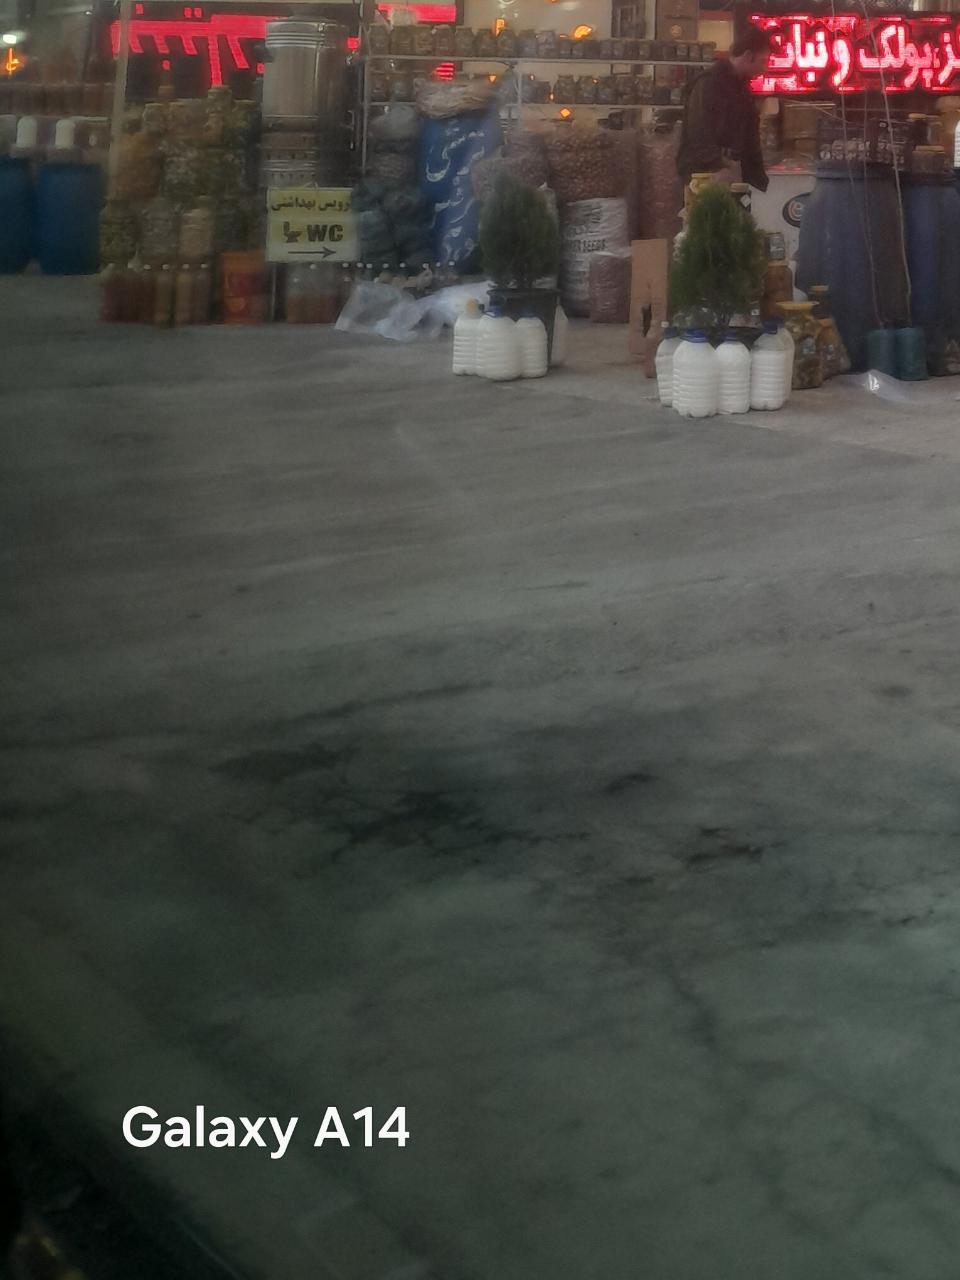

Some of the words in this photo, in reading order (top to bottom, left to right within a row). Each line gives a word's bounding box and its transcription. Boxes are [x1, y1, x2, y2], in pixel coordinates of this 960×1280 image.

[832, 38, 851, 87] و
[858, 23, 933, 88] پولک
[306, 223, 344, 243] WC
